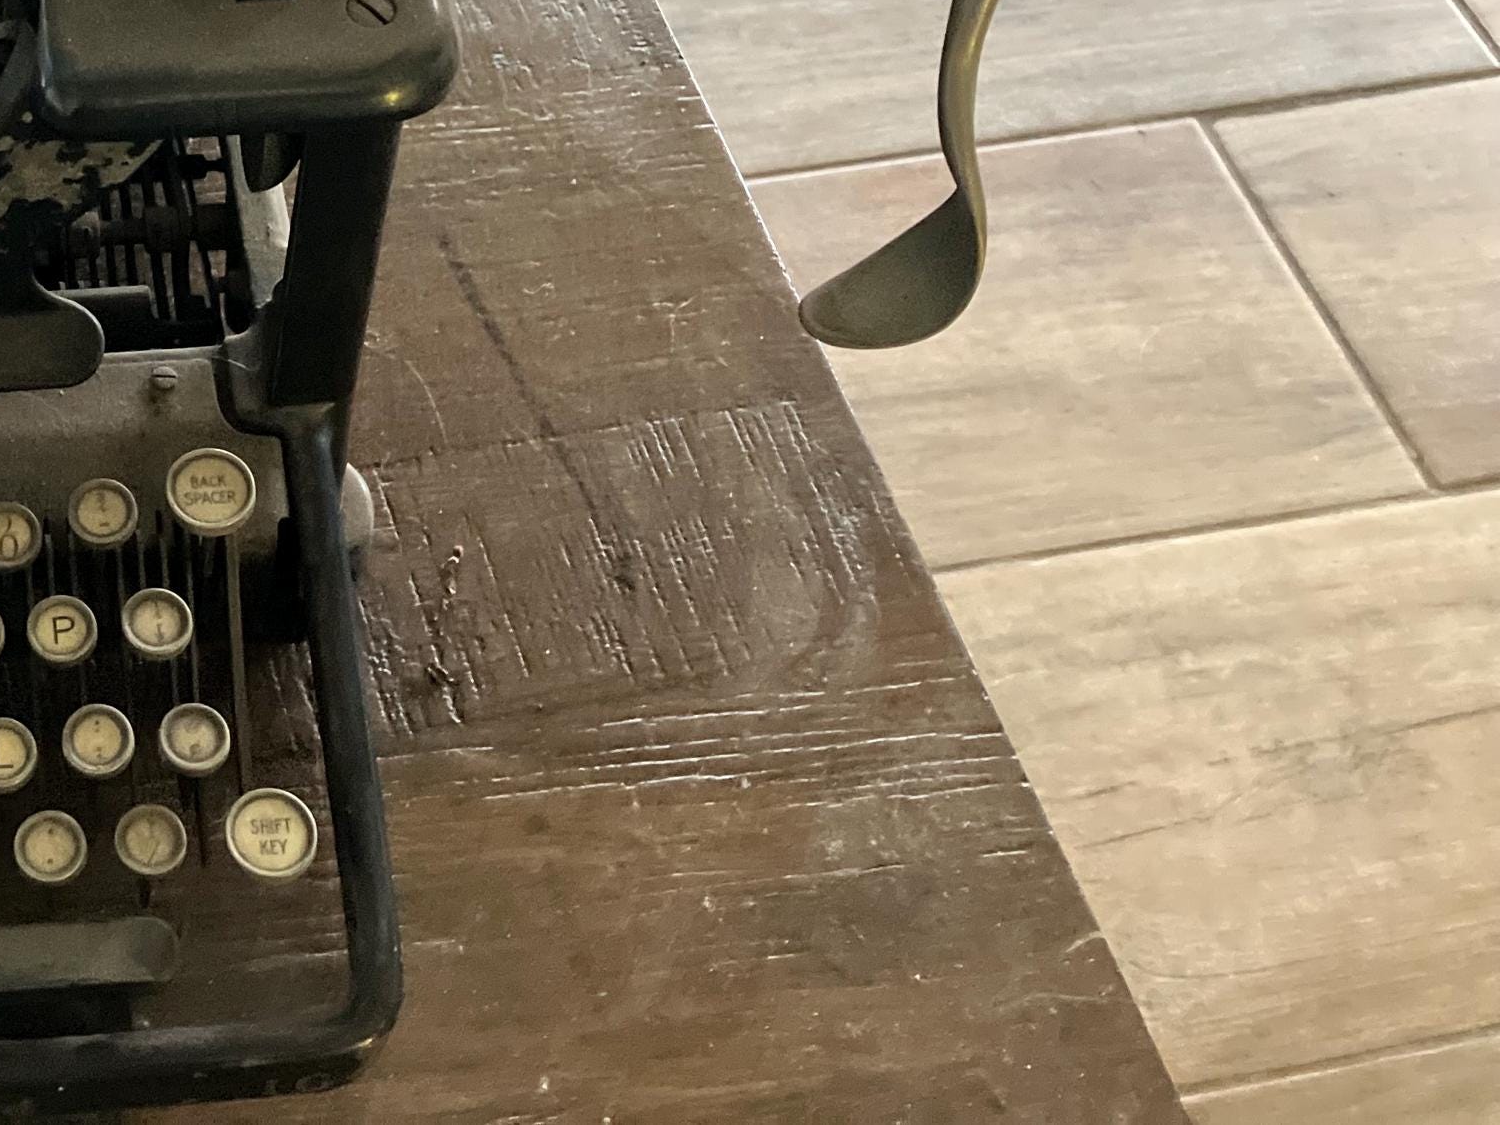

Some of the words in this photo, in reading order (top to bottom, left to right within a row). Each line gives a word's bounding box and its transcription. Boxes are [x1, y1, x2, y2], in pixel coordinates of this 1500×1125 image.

[190, 475, 227, 489] BACK
[184, 490, 236, 505] SPACER
[52, 616, 75, 644] P
[250, 817, 291, 835] SHIFT
[259, 838, 288, 855] KEY
